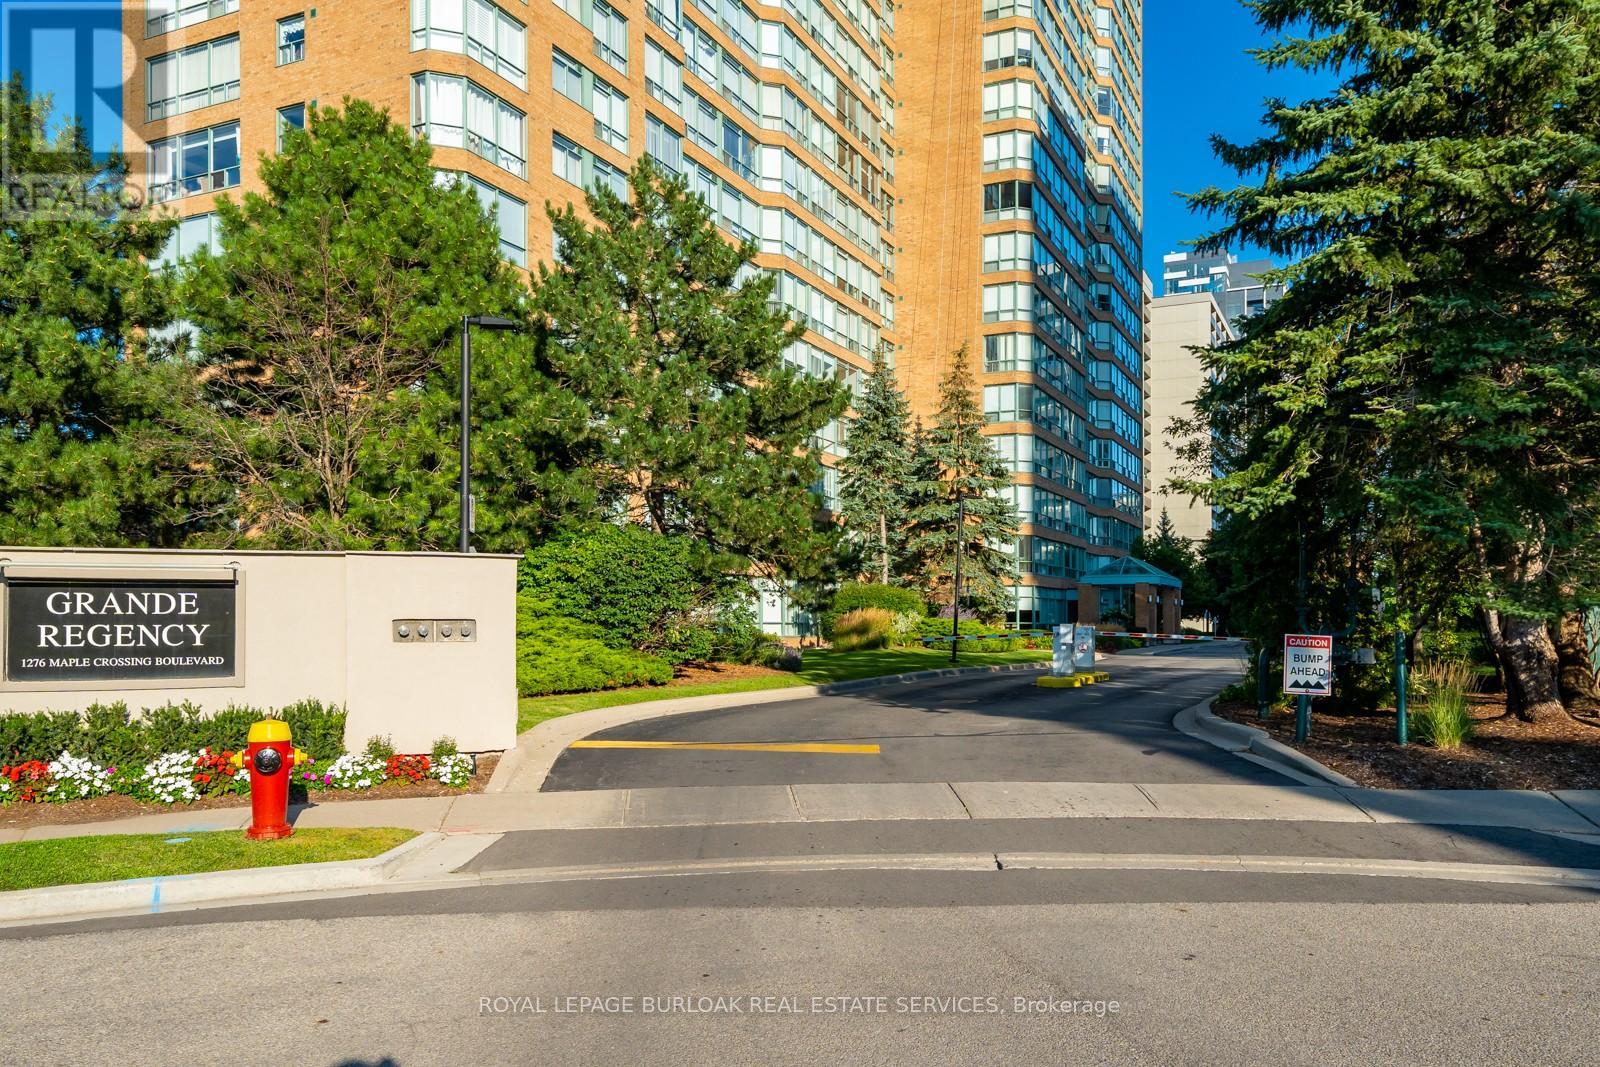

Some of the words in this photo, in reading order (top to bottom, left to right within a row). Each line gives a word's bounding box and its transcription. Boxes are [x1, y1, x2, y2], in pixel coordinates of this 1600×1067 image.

[46, 591, 200, 615] GRANDE
[37, 623, 211, 648] REGENCY
[1289, 638, 1328, 647] CAUTION
[21, 658, 47, 668] 1276
[48, 657, 91, 668] MAPLE
[93, 656, 152, 667] CROSSING
[154, 656, 225, 666] BOULEVARD
[1293, 653, 1323, 664] BUMP
[1290, 666, 1326, 677] AHEAD
